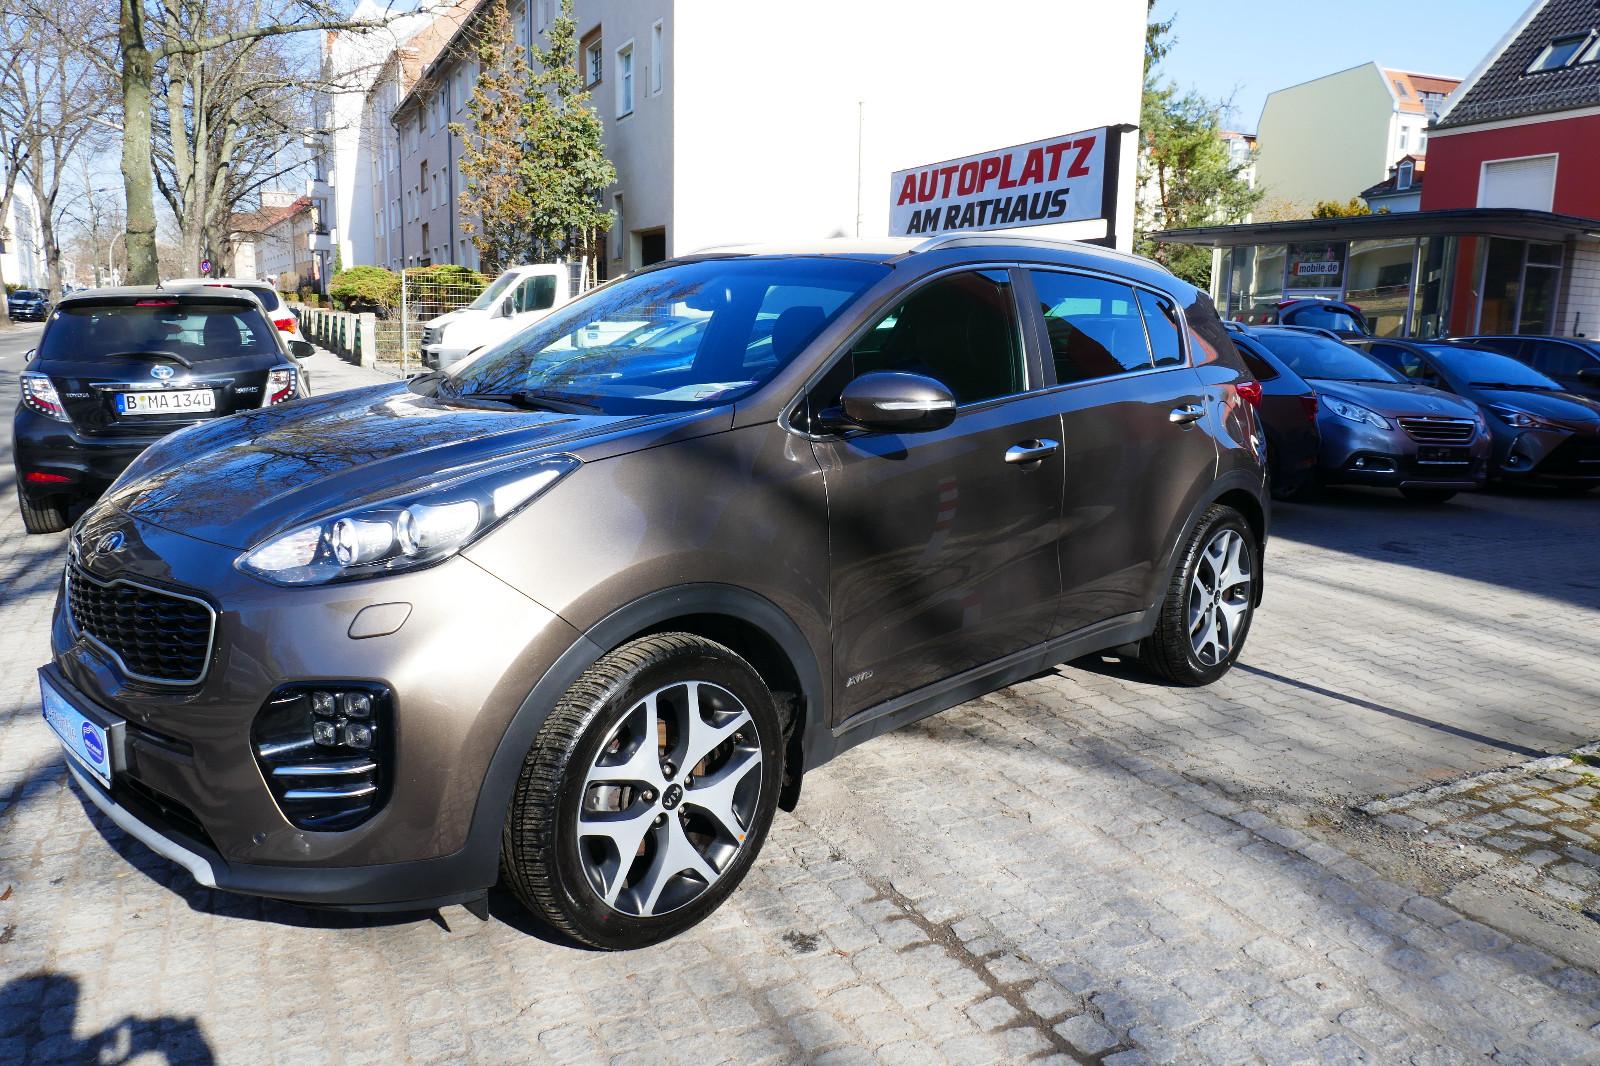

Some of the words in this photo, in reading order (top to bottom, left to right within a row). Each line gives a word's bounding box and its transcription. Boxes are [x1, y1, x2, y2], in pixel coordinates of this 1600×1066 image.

[897, 136, 1096, 206] AUTOPLATZ
[906, 207, 941, 234] AM
[943, 188, 1070, 231] RATHAUS
[1299, 263, 1338, 273] mobile.de
[126, 395, 137, 409] B
[148, 395, 169, 409] MA
[172, 393, 212, 408] 1340
